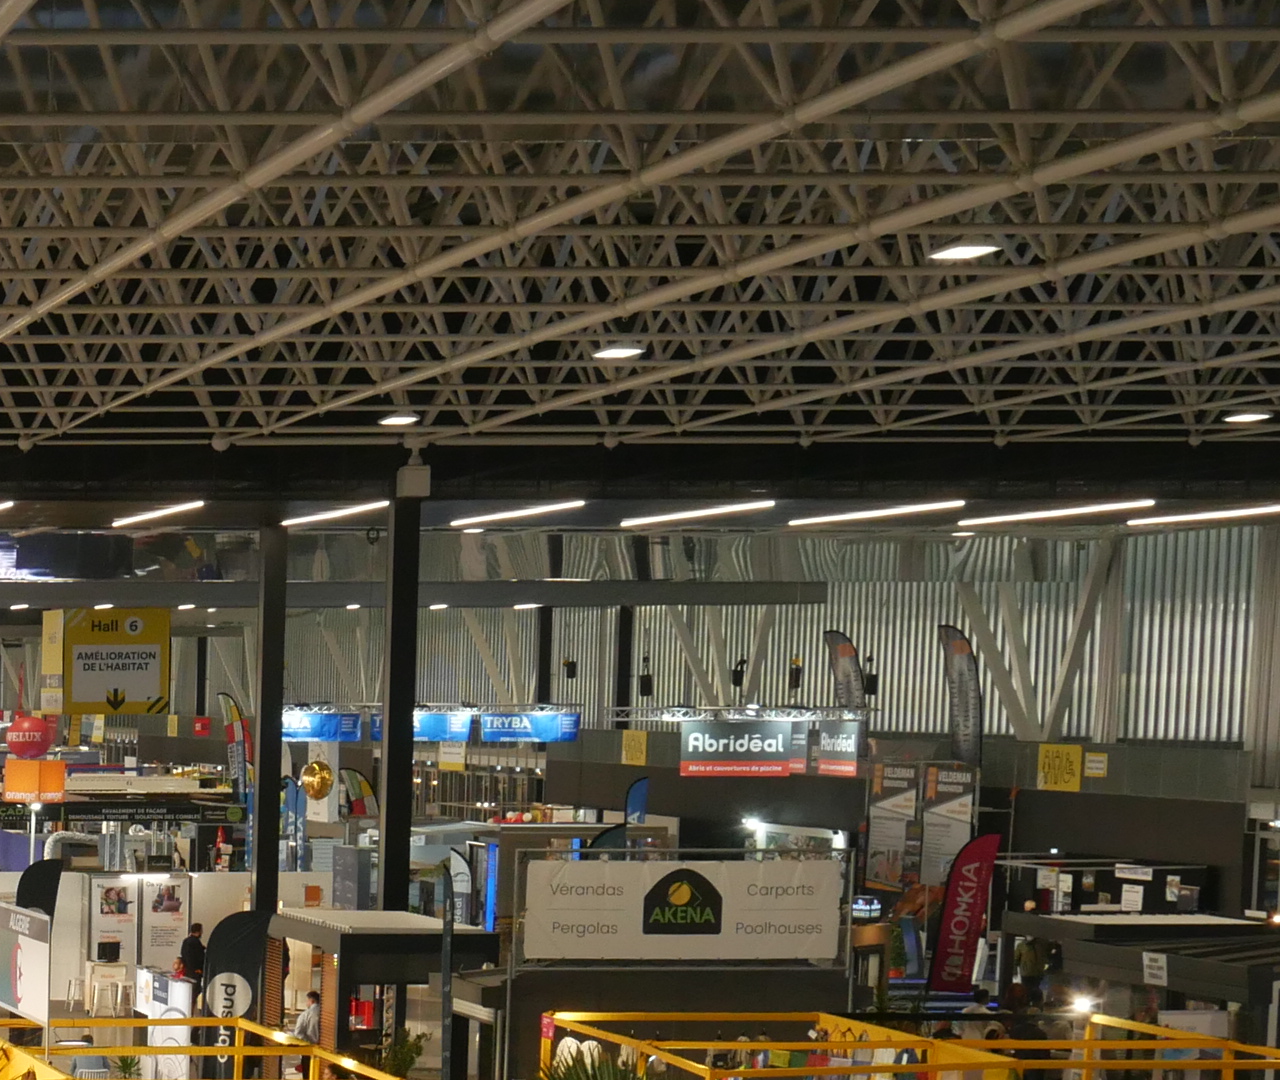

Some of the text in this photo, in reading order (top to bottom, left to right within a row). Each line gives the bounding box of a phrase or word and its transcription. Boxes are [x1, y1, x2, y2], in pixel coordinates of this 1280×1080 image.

[91, 620, 138, 632] Hall 6
[77, 650, 156, 661] AMÉLIORATION
[83, 662, 150, 672] DE L'HABITAT
[484, 716, 532, 729] TRYBA
[7, 731, 42, 742] VELUX
[6, 791, 36, 800] orange
[40, 790, 63, 800] orange
[550, 883, 624, 896] Vérandas
[747, 883, 814, 900] Carports
[649, 906, 716, 924] AKENA
[8, 912, 30, 935] ALGERIE
[552, 921, 618, 937] Pergolas
[735, 921, 822, 935] Poolhouses
